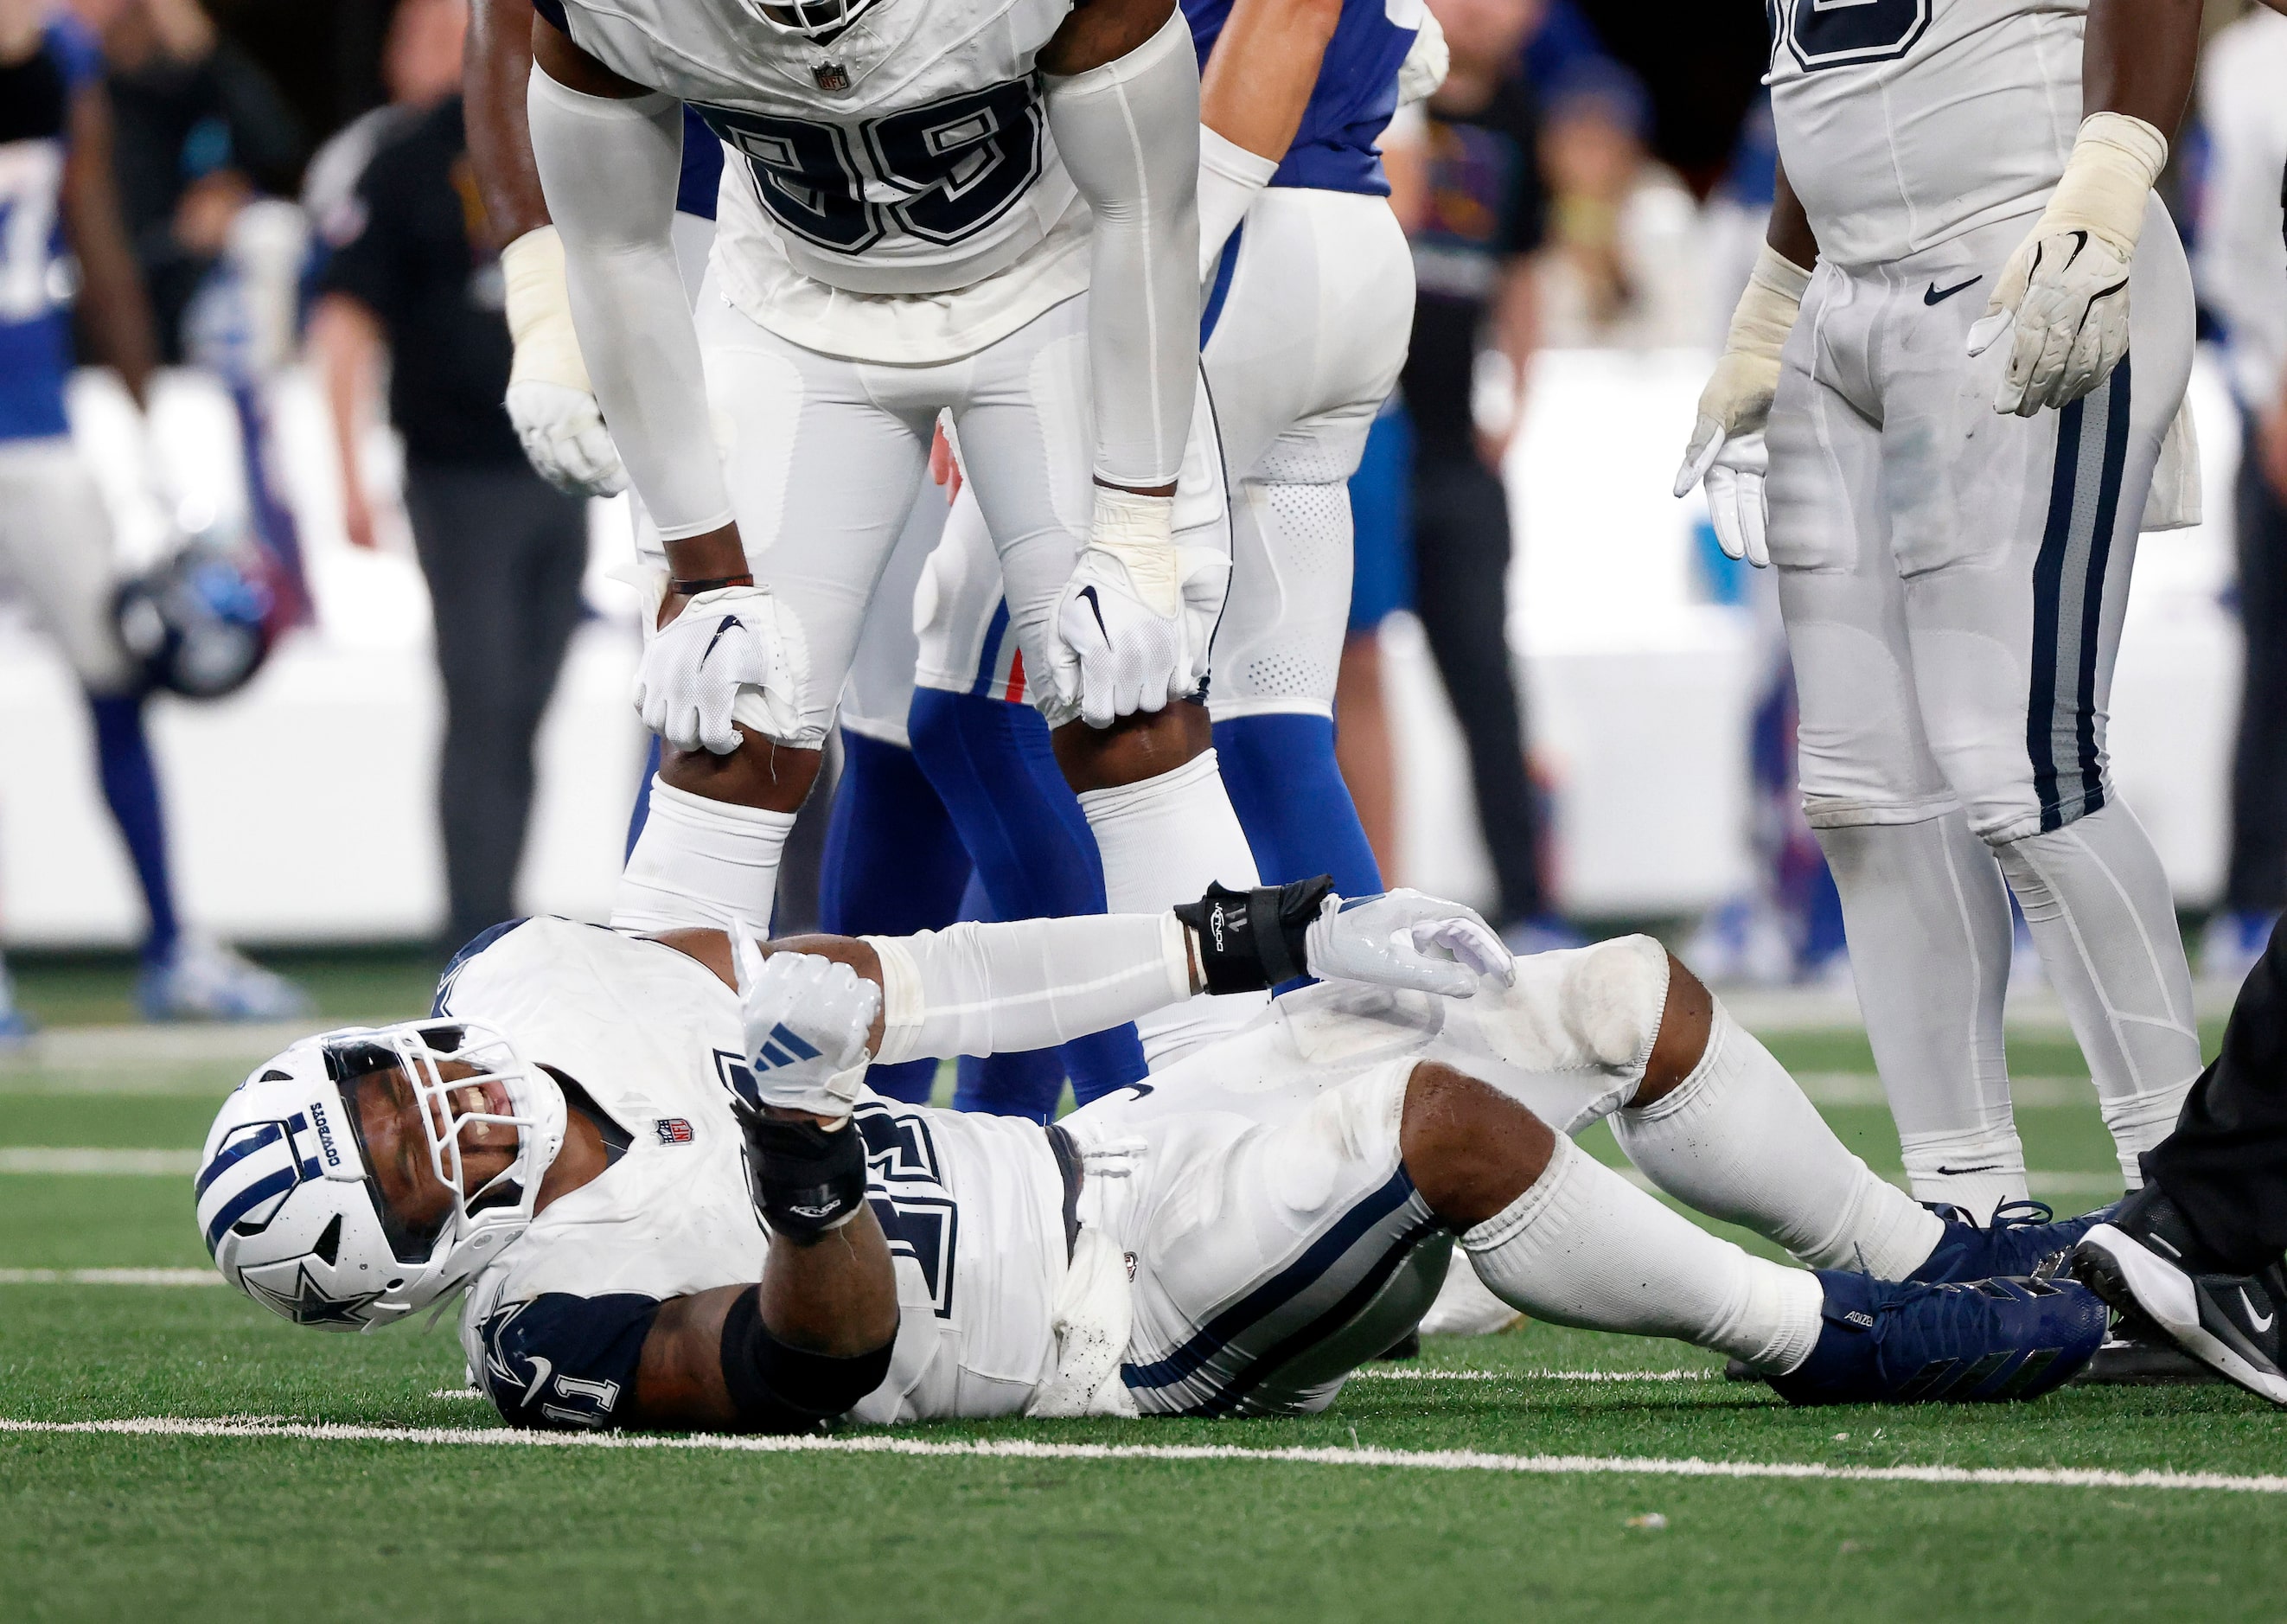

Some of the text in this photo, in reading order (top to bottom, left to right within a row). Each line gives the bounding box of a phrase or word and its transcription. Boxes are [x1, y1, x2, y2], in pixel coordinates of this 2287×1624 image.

[821, 75, 847, 89] NFL
[310, 1102, 341, 1167] COWBOYS
[669, 1120, 689, 1141] NFL
[541, 1373, 621, 1428] 11
